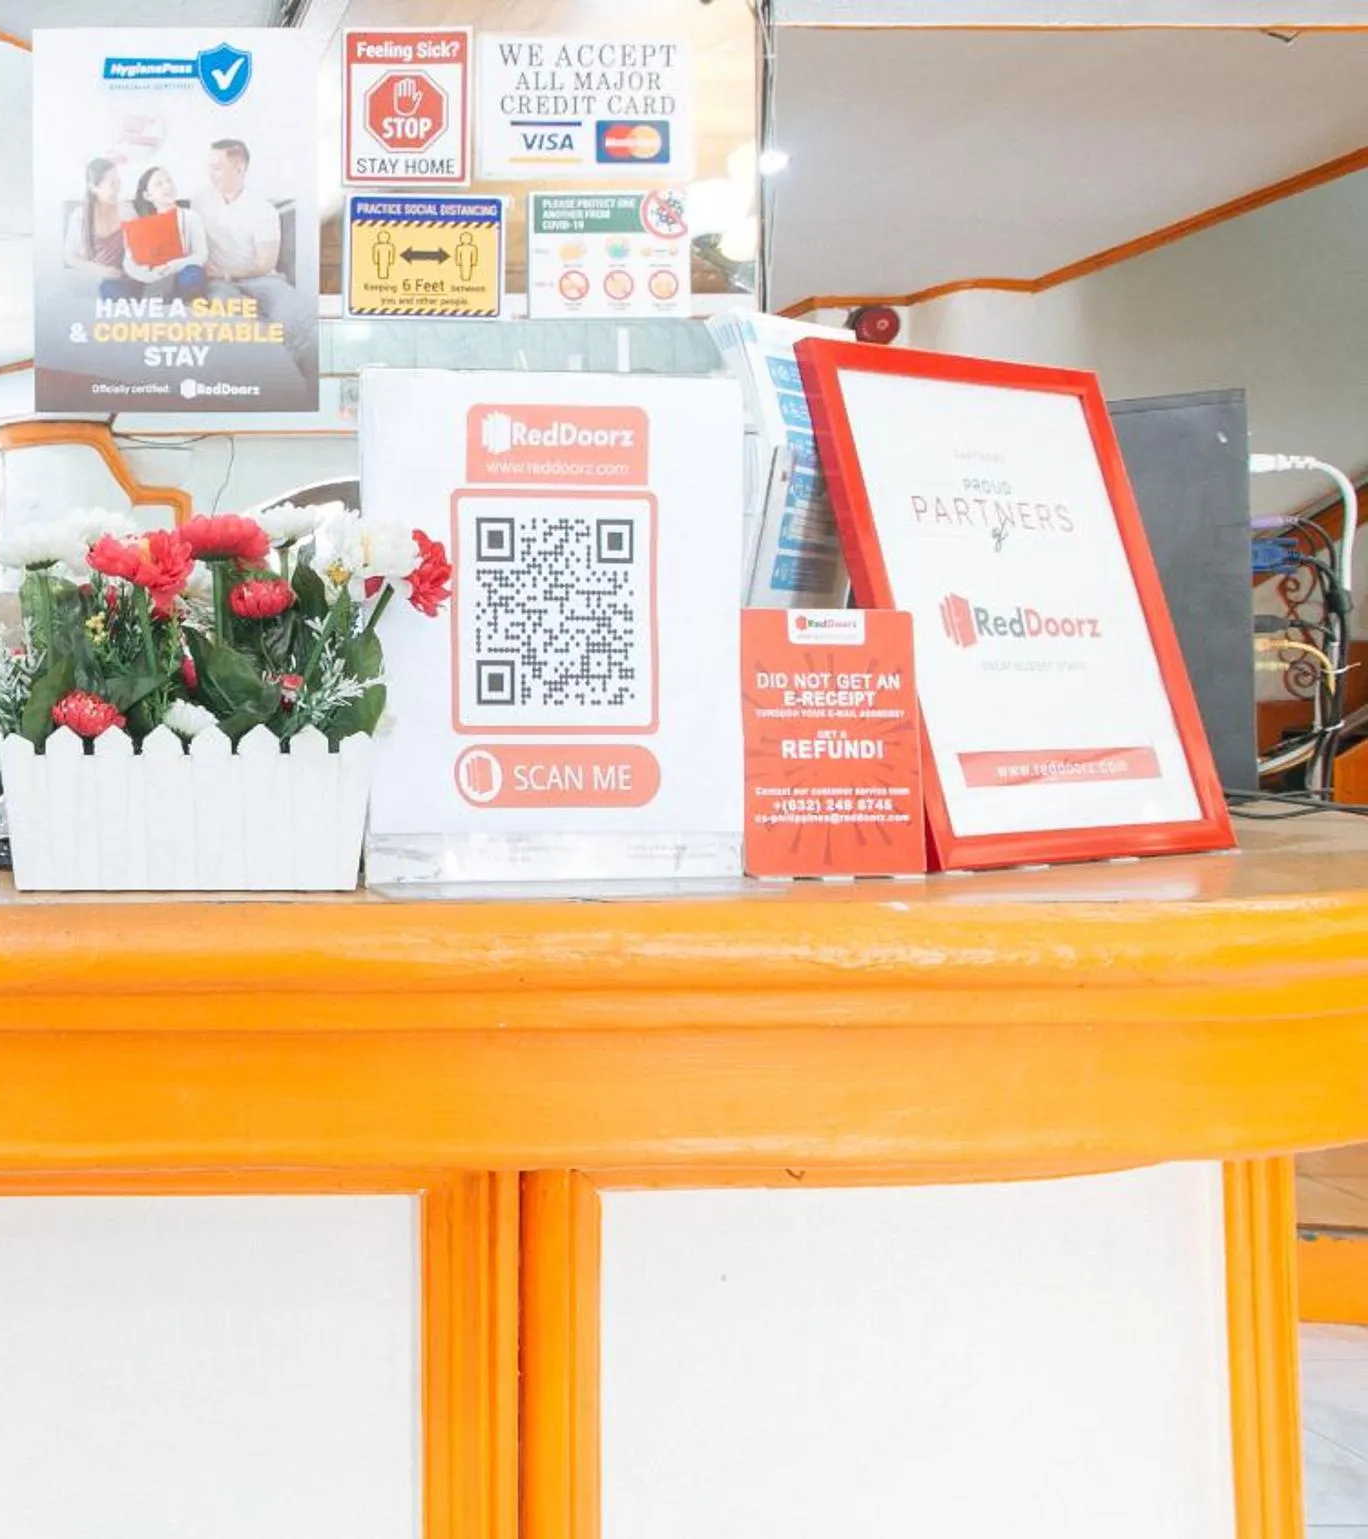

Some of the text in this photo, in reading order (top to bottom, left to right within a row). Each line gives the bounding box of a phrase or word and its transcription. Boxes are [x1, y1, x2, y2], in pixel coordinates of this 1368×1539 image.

[357, 41, 461, 62] Feeling Sick?
[498, 43, 677, 68] WE ACCEPT
[515, 71, 662, 91] ALL MAJOR
[499, 95, 676, 115] CREDIT CARD
[381, 117, 433, 139] STOP
[522, 133, 574, 150] VISA
[356, 158, 455, 175] STAY HOME
[356, 202, 498, 216] PRACTICE SOCIAL DISTANCING
[541, 220, 584, 230] COVID-19
[401, 278, 411, 292] 6
[415, 279, 445, 292] Feet
[95, 297, 258, 319] HAVE A SAFE
[69, 322, 284, 343] & COMFORTABLE
[143, 346, 210, 367] STAY
[196, 382, 260, 395] RedDoorz
[511, 420, 635, 447] RedDoorz
[486, 457, 630, 476] www.reddoorz.com
[910, 495, 1075, 533] PARTNERS
[973, 606, 1103, 638] RedDoorz
[756, 672, 901, 690] DID NOT GET AN
[783, 690, 876, 707] E-RECEIPT
[781, 739, 884, 759] REFUND!
[512, 765, 632, 791] SCAN ME
[997, 759, 1129, 778] www.reddoorz.com
[755, 787, 790, 796] Contact
